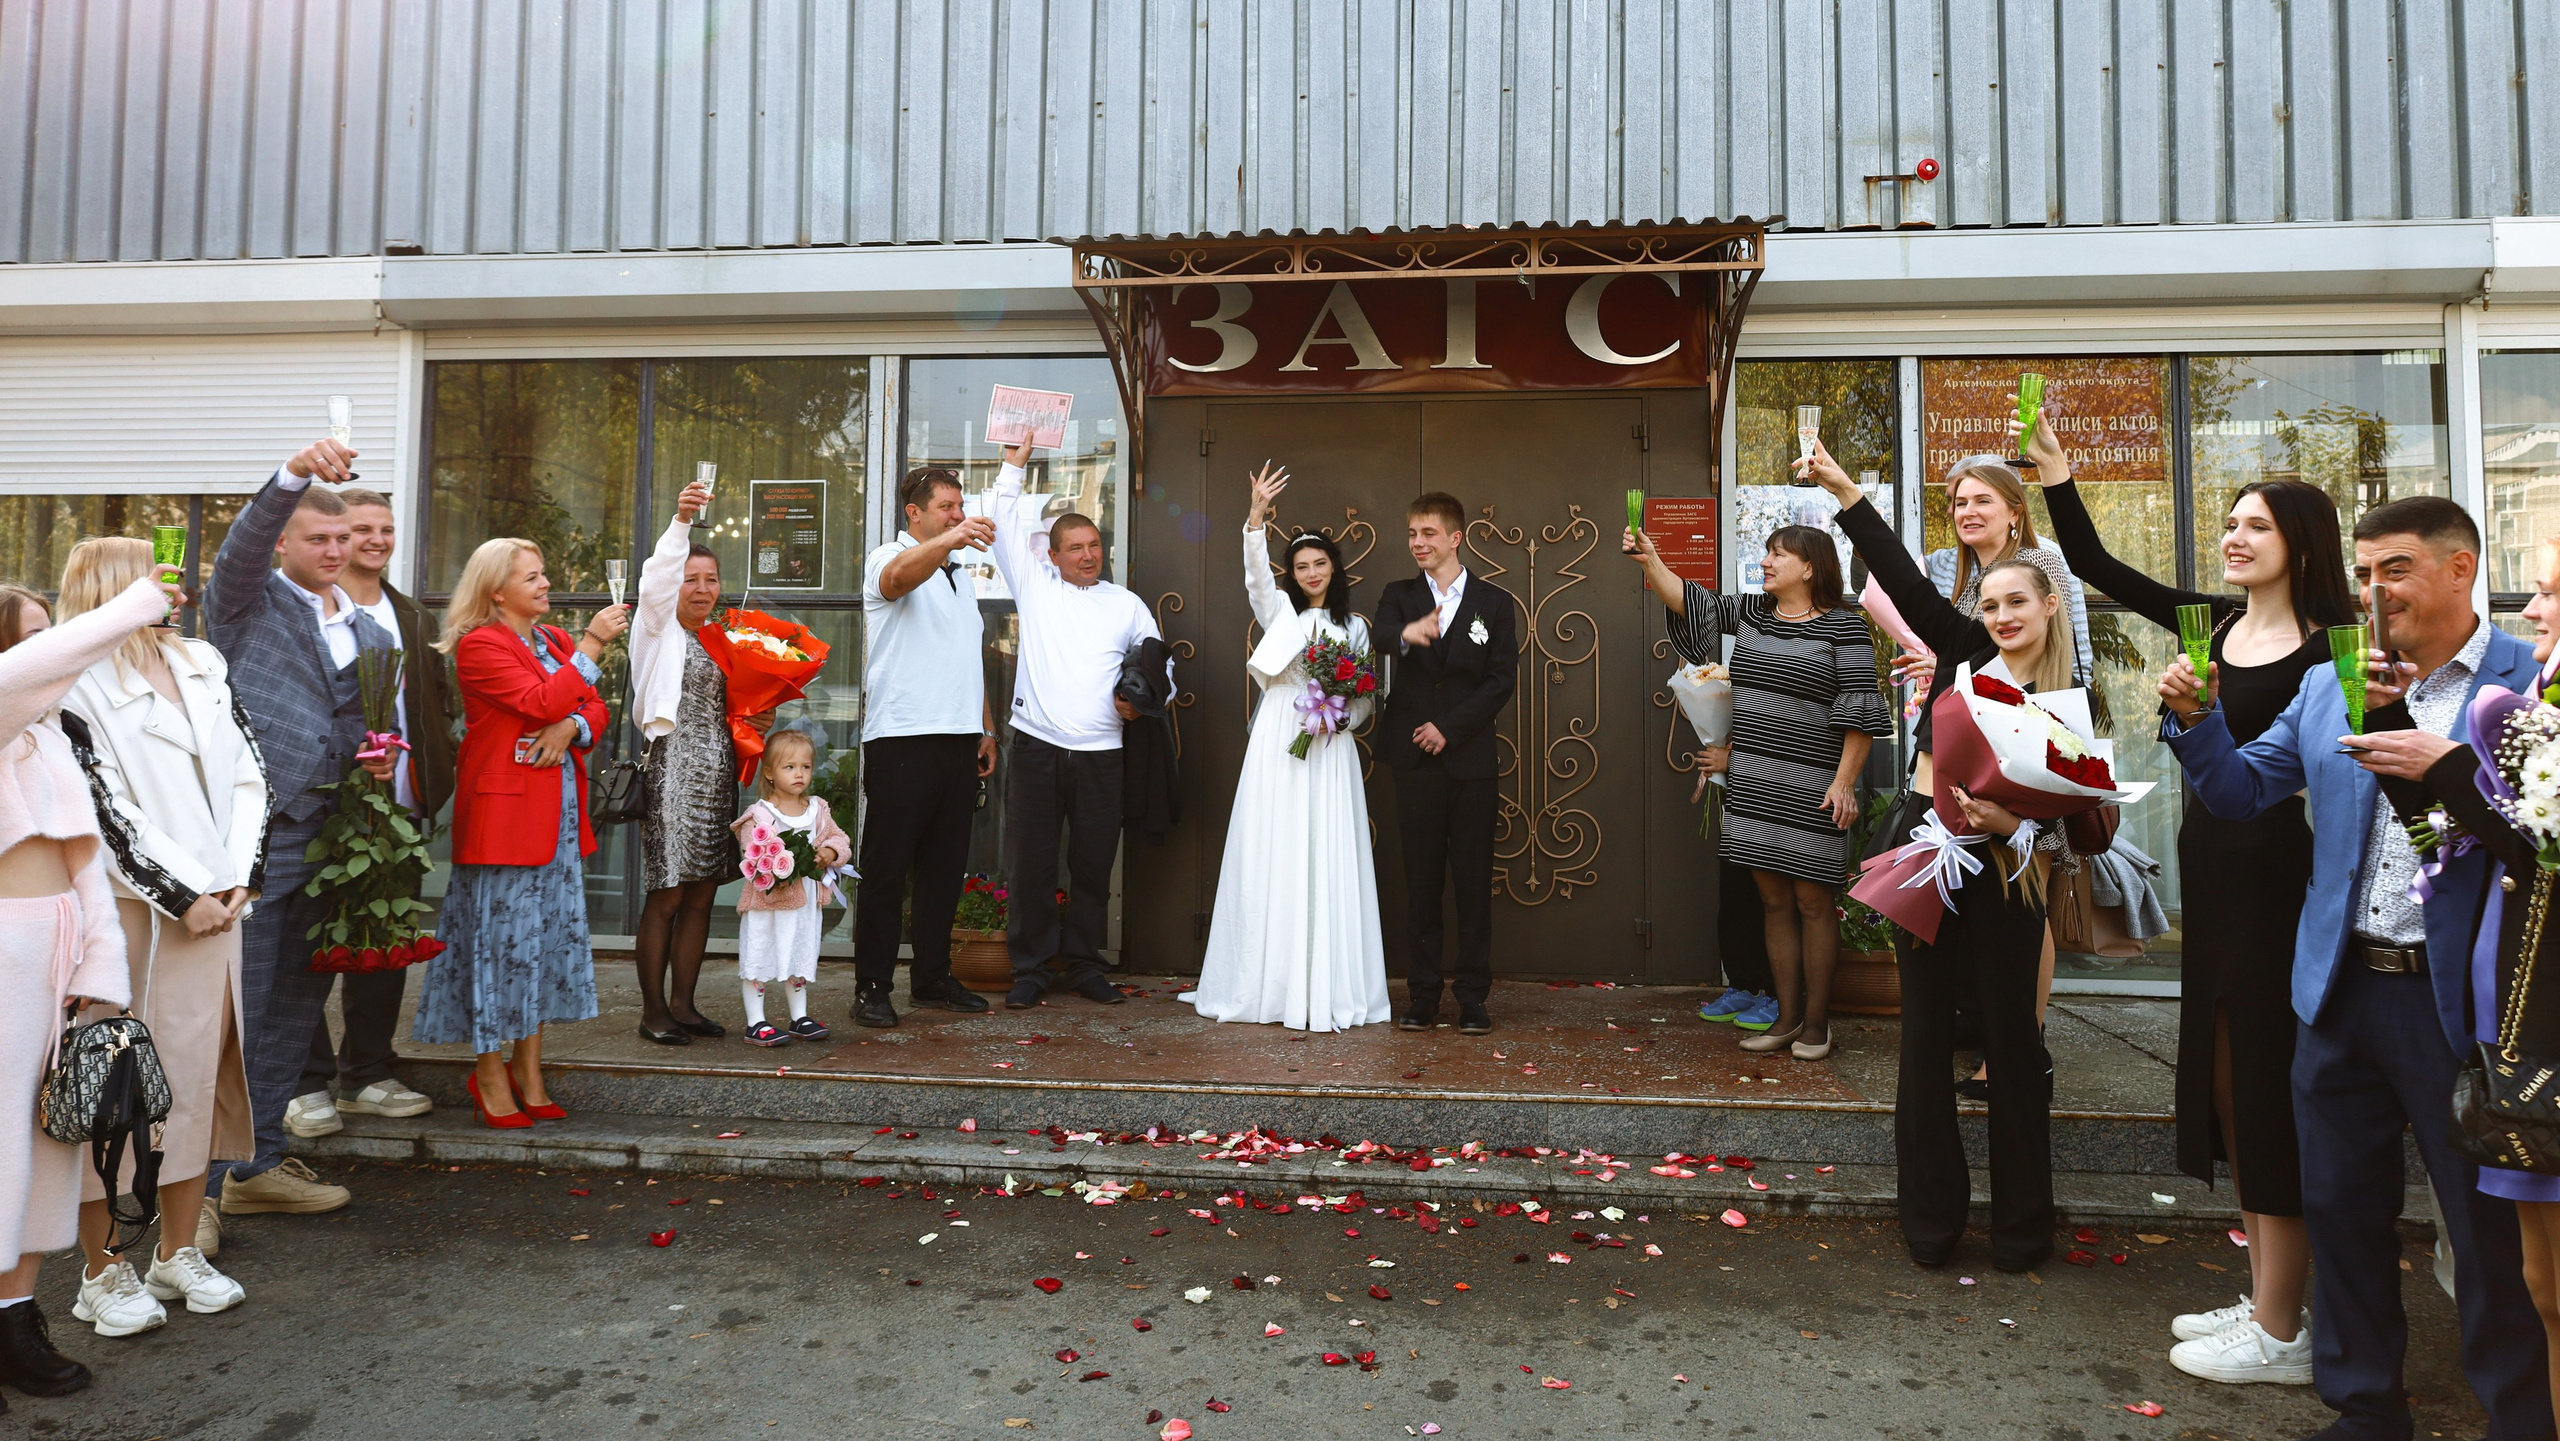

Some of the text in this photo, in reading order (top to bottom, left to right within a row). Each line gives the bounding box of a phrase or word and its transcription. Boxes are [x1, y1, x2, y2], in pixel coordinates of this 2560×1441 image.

[1167, 271, 1681, 372] ЗАГС
[1943, 377, 2018, 389] Артемовског
[2099, 376, 2140, 388] округа
[1928, 411, 2159, 439] Управлен аписи актов
[2064, 446, 2160, 463] состояния
[2518, 1067, 2554, 1102] CHANEL
[2505, 1131, 2534, 1167] PARIS
